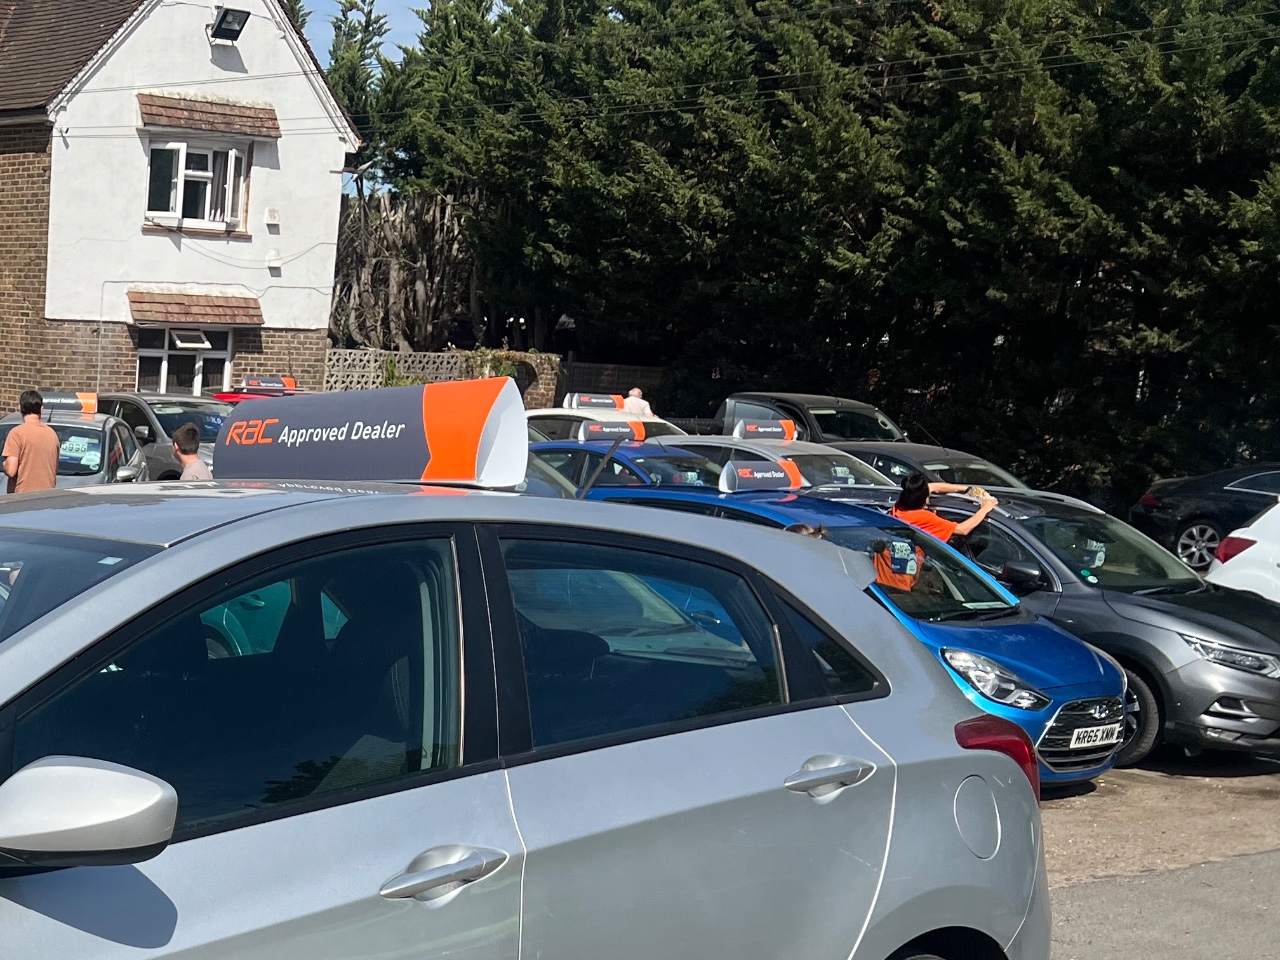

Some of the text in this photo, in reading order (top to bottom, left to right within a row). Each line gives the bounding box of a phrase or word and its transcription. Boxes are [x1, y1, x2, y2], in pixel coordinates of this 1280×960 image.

[225, 417, 406, 448] RAC Approved Dealer
